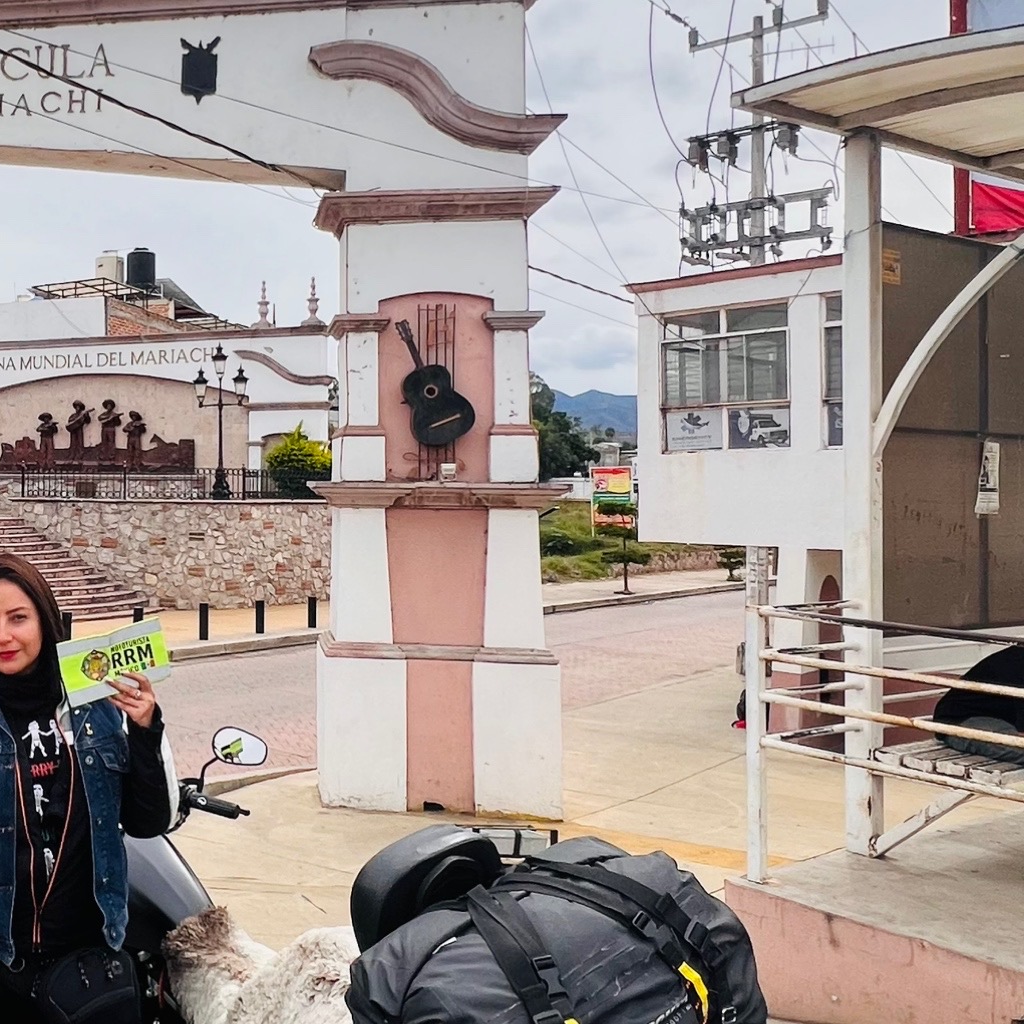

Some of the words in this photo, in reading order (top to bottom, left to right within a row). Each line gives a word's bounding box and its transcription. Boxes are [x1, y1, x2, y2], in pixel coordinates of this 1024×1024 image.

[20, 353, 92, 370] MUNDIAL
[96, 352, 126, 367] DEL
[130, 347, 214, 366] MARIACH
[111, 644, 153, 668] RRM
